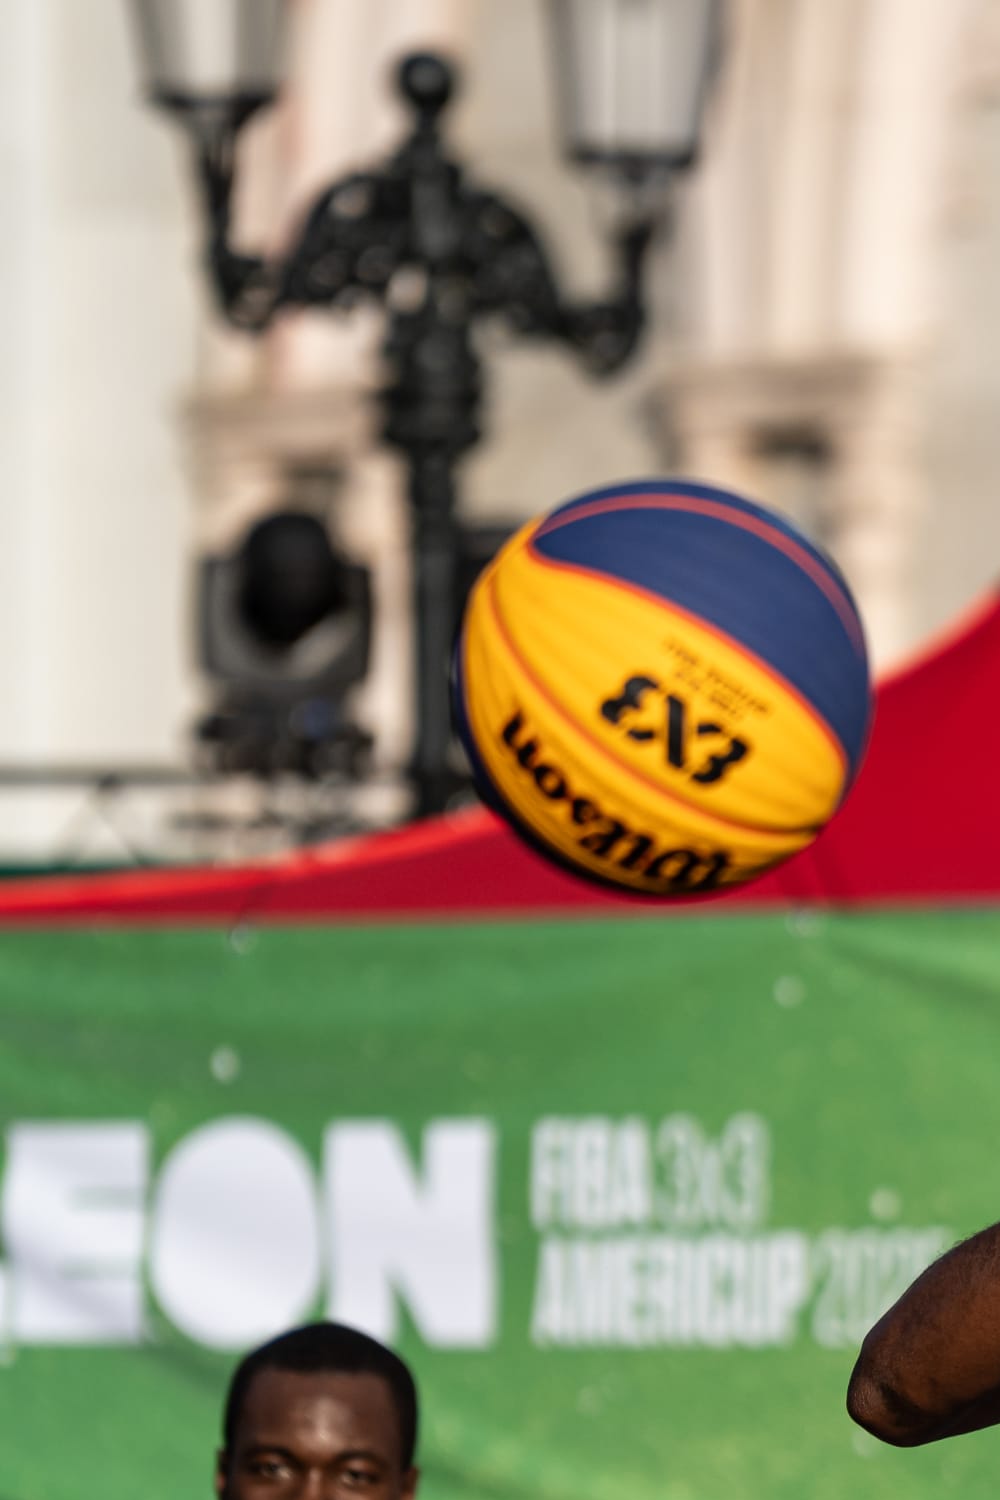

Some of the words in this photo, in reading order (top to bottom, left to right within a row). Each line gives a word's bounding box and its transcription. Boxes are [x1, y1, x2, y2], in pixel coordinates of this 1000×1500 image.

[0, 1112, 497, 1350] EON
[531, 1113, 652, 1230] FIBA
[531, 1228, 808, 1347] AMERICUP
